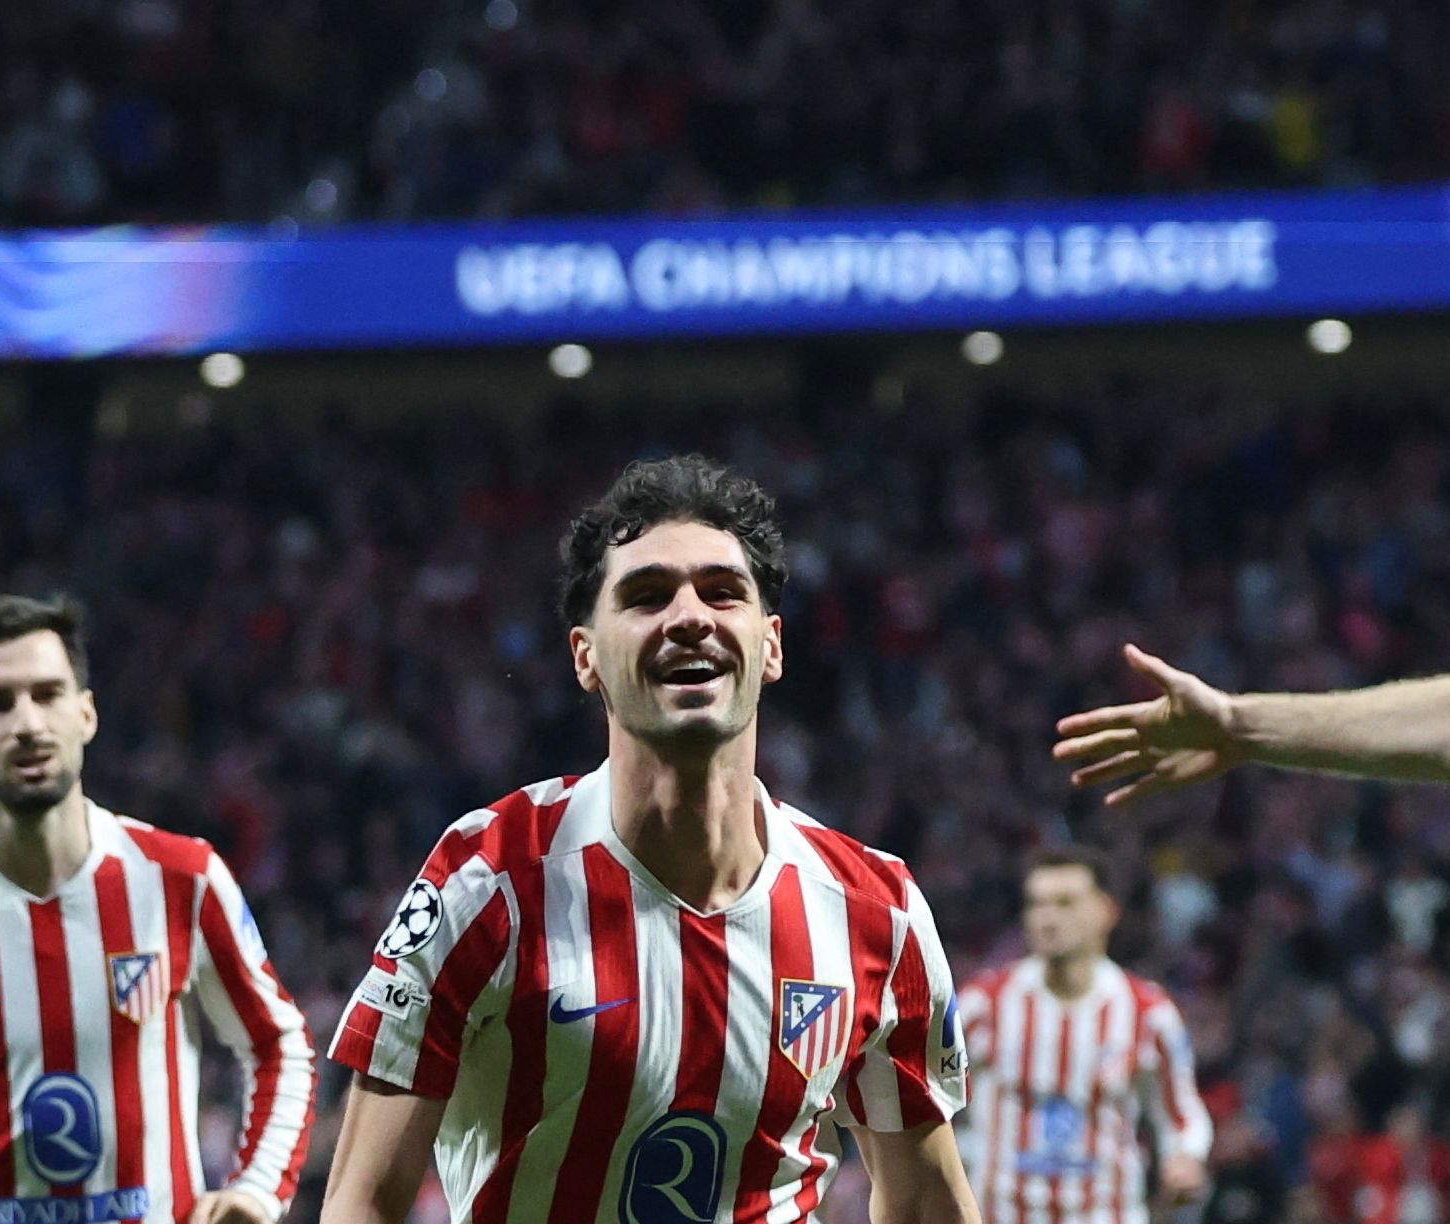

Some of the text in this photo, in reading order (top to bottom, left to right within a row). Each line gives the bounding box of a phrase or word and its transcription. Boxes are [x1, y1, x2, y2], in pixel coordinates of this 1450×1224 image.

[457, 220, 1275, 314] UEFA CHAMPIONS LEAGUE
